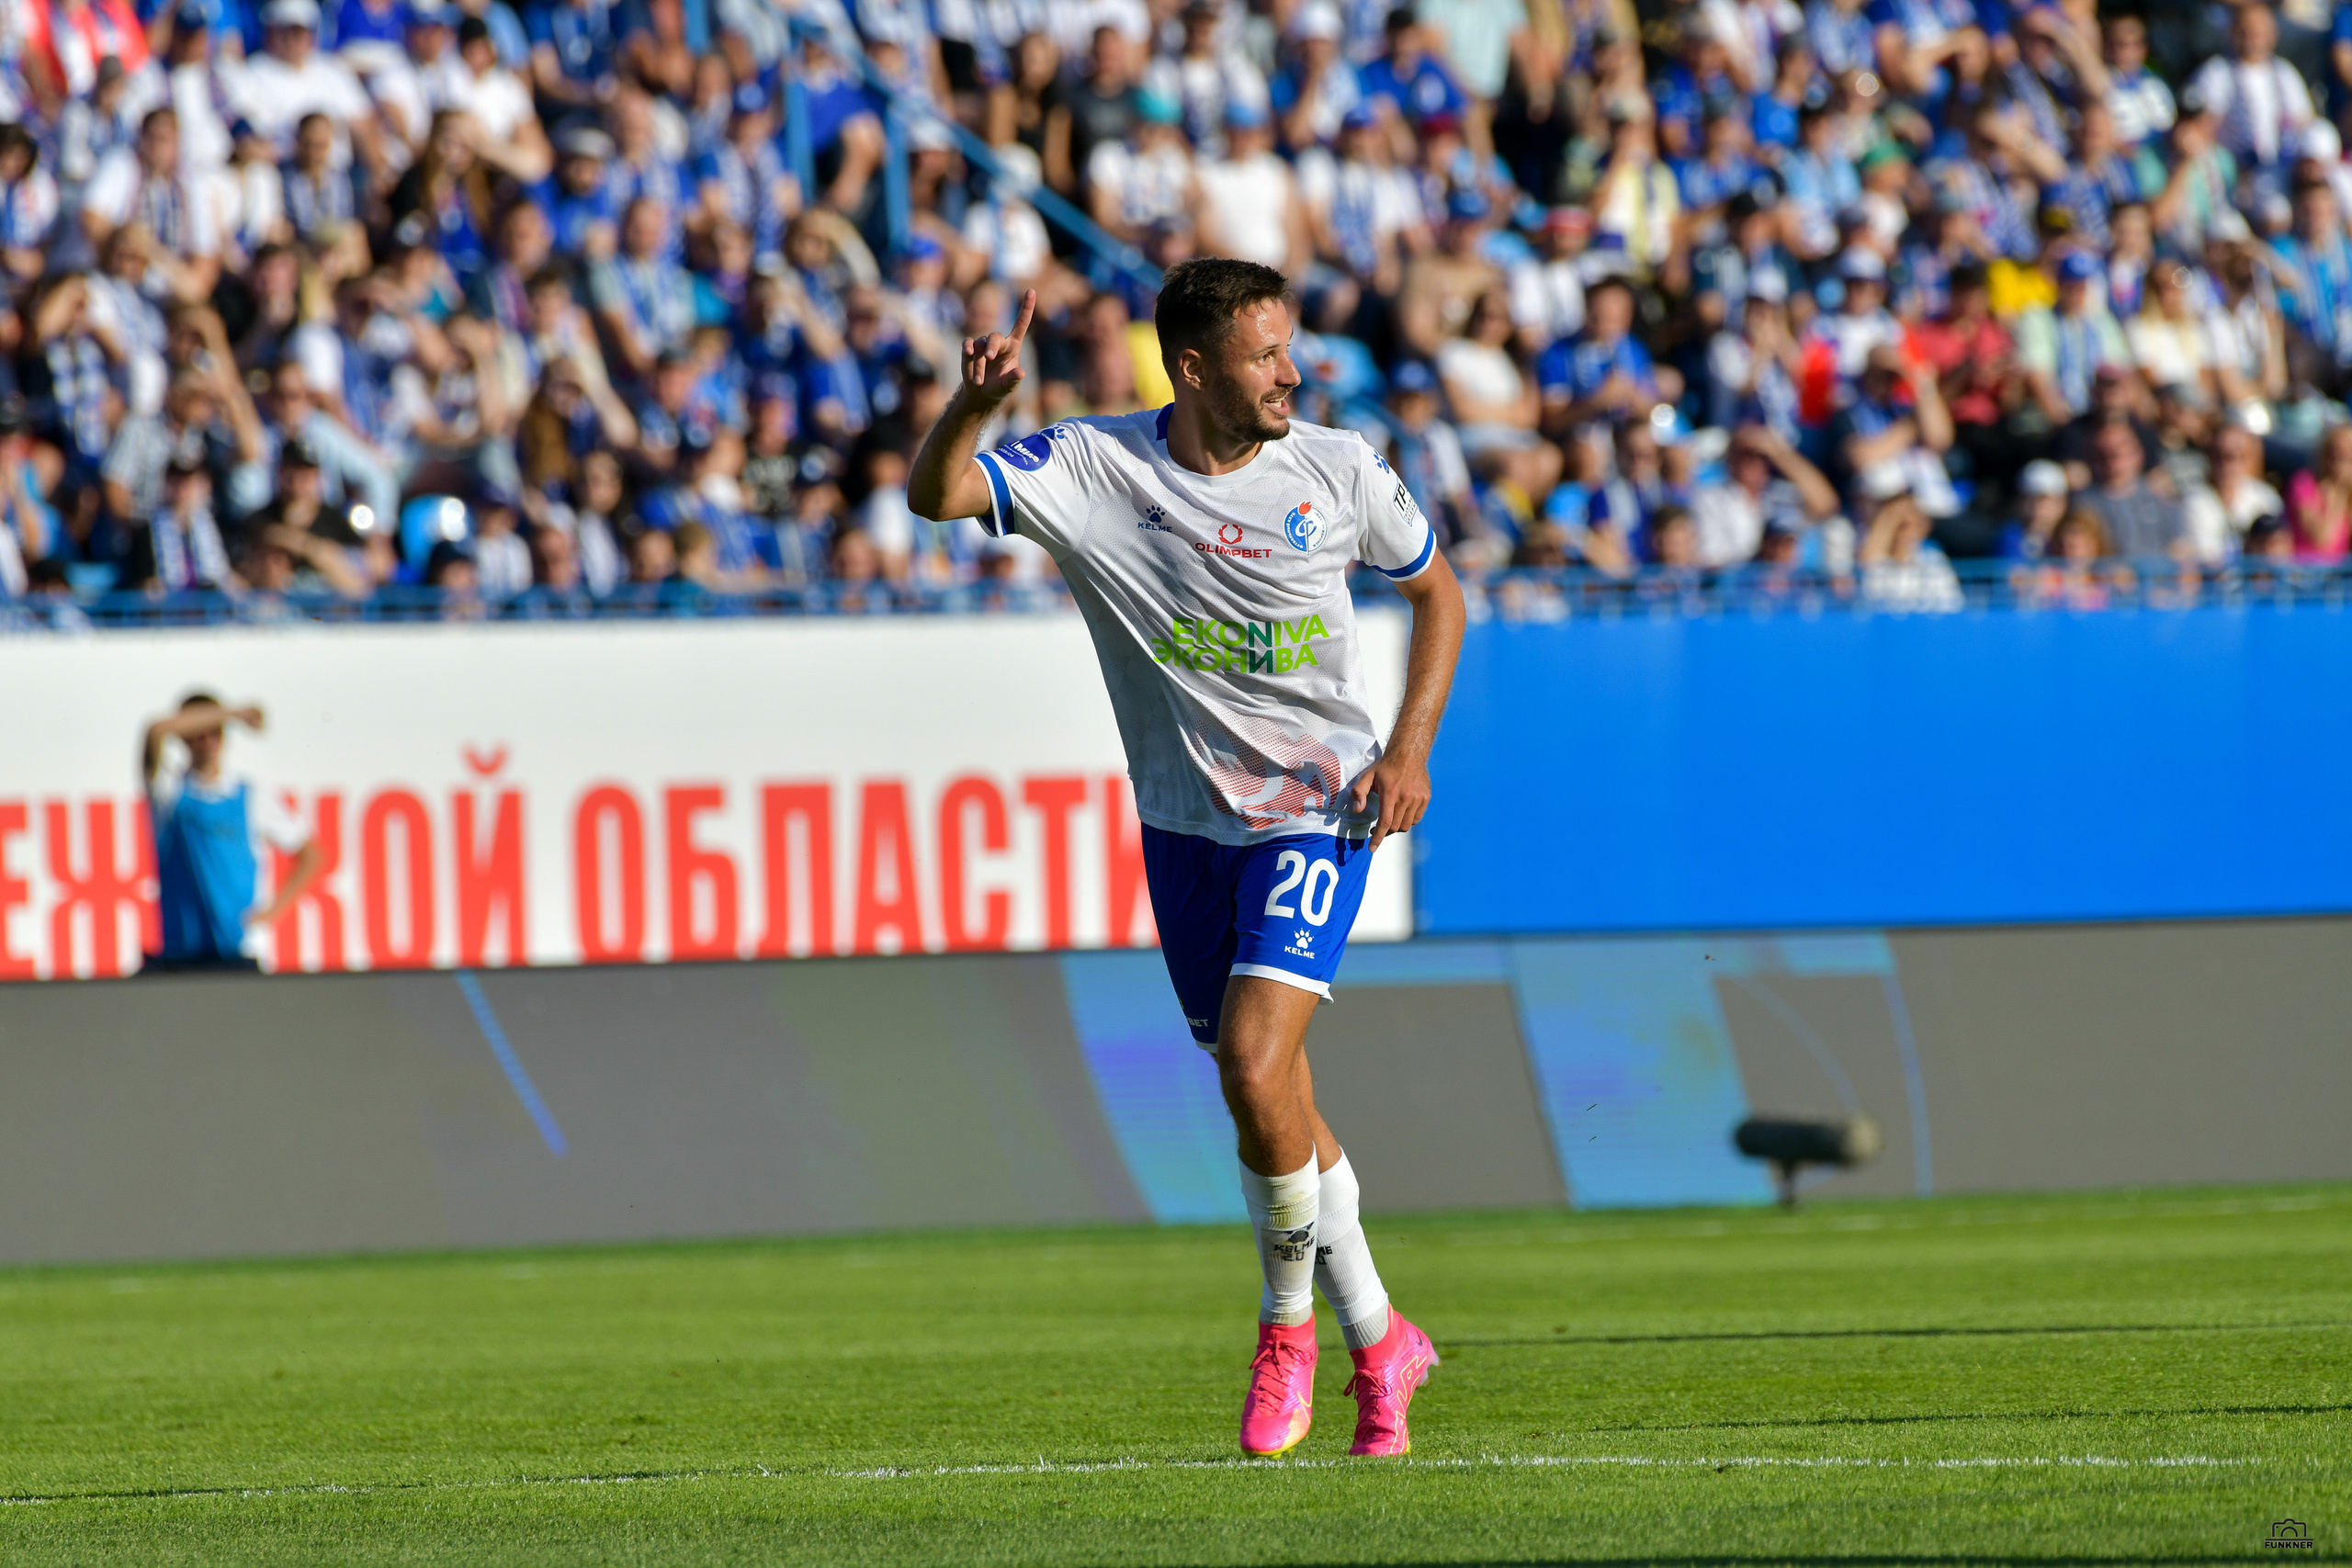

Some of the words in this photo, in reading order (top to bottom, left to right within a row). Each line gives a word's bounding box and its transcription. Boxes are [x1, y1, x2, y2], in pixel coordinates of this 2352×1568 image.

[1137, 522, 1172, 533] KELME
[1194, 542, 1272, 558] OLIMPBET
[1172, 614, 1330, 648] EKONIVA
[1151, 638, 1318, 674] ЭКОНИВА
[1264, 850, 1340, 927] 20
[1284, 945, 1316, 960] KELME
[1186, 1017, 1208, 1027] BET
